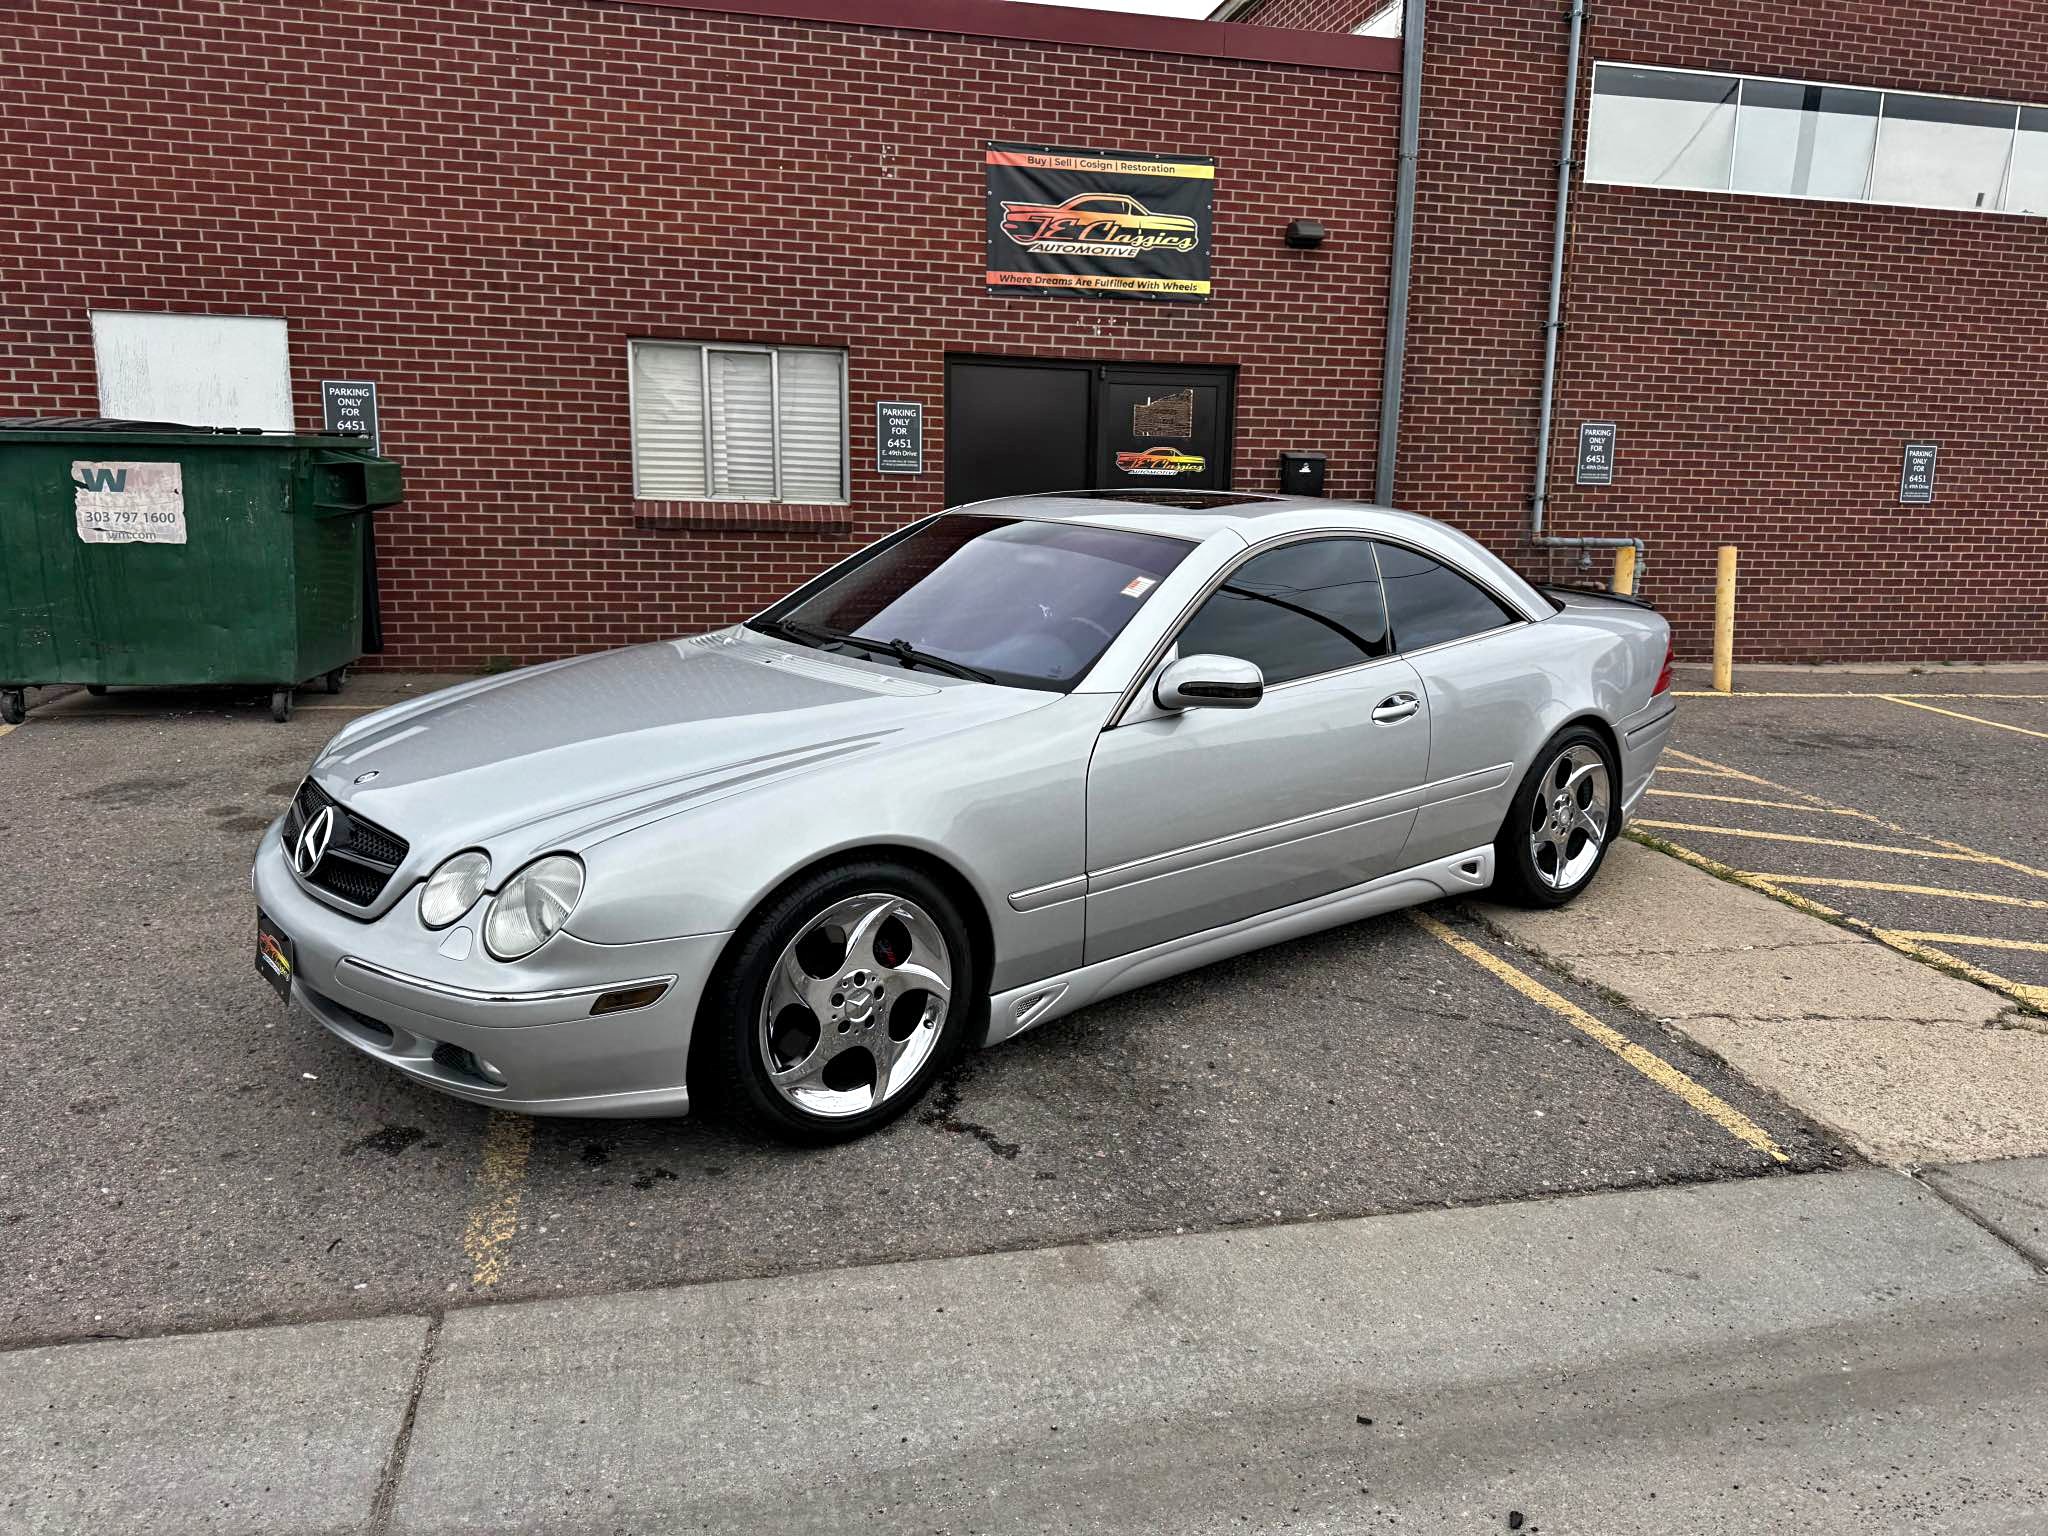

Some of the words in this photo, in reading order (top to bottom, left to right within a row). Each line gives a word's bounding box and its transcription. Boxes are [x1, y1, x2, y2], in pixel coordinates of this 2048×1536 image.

[1027, 156, 1047, 166] Buy
[1055, 158, 1072, 167] Sell
[1080, 160, 1113, 171] Cosign
[1120, 162, 1175, 173] Restoration
[1074, 218, 1193, 248] Classics
[1034, 242, 1138, 257] AUTOMOTIVE
[999, 274, 1032, 284] Where
[1034, 276, 1073, 286] Dreams
[1075, 278, 1092, 287] Are
[1095, 278, 1134, 289] Fulfilled
[1137, 280, 1160, 290] With
[1162, 282, 1198, 292] Wheels
[329, 387, 369, 397] PARKING
[337, 397, 362, 406] ONLY
[341, 408, 360, 416] FOR
[882, 408, 917, 417] PARKING
[337, 420, 366, 431] 6451
[889, 418, 910, 426] ONLY
[891, 427, 908, 435] FOR
[1584, 429, 1612, 437] PARKING
[887, 439, 912, 449] 6451
[1586, 454, 1605, 464] 6451
[1909, 450, 1933, 458] PARKING
[1912, 457, 1928, 465] ONLY
[1909, 474, 1927, 483] 6451
[86, 511, 110, 523] 303
[113, 511, 138, 523] 797
[143, 512, 176, 523] 1600
[107, 530, 156, 541] wm.com
